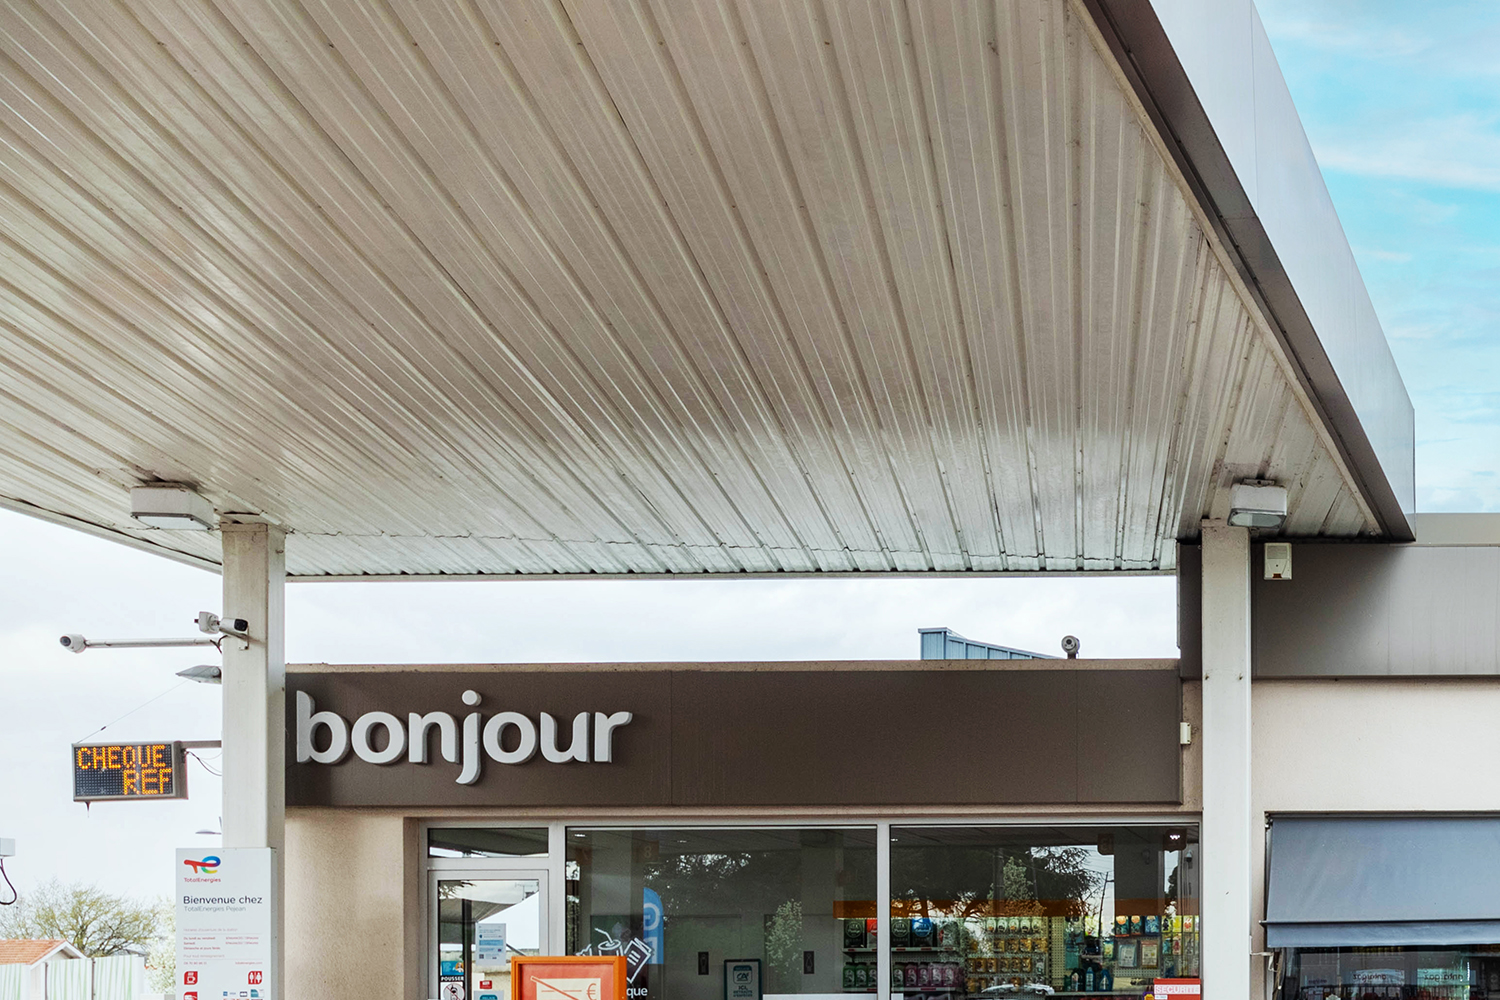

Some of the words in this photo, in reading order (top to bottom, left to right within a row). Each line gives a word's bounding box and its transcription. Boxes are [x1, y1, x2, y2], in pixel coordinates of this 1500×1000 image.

[296, 689, 633, 785] bonjour
[77, 744, 166, 770] CHEQUE
[123, 768, 172, 795] REF
[183, 895, 236, 904] Bienvenue
[238, 895, 263, 904] chez
